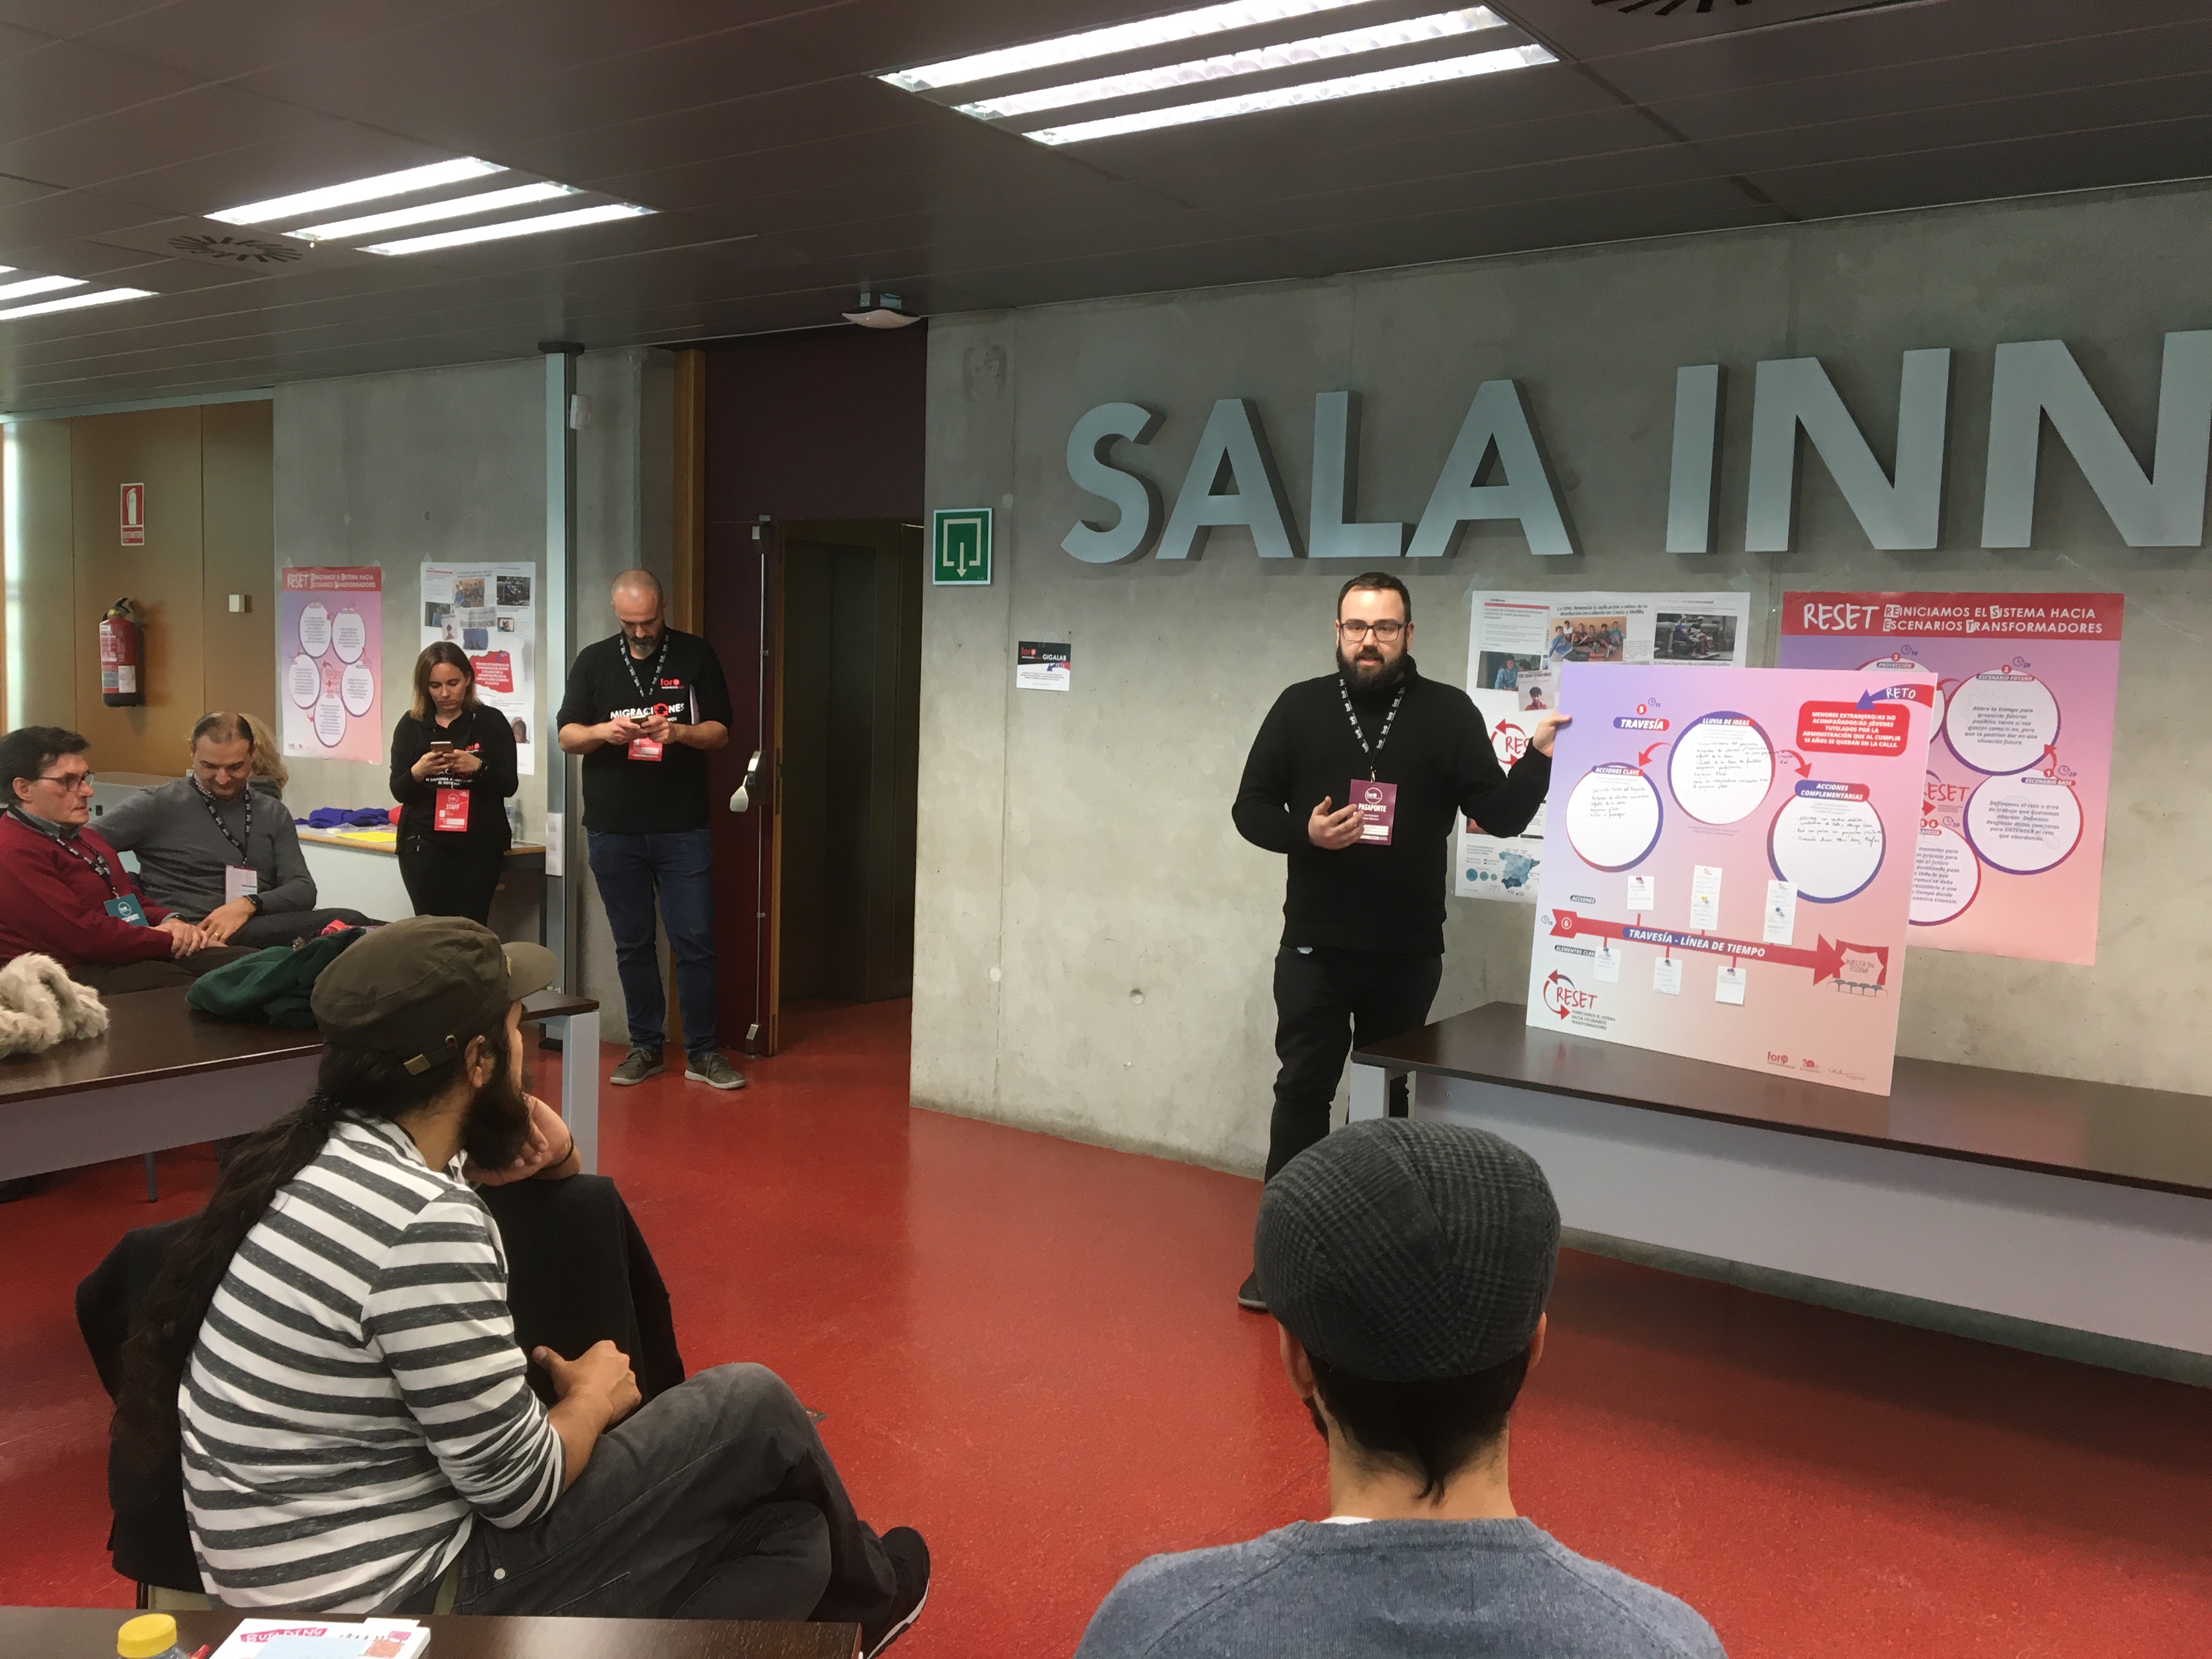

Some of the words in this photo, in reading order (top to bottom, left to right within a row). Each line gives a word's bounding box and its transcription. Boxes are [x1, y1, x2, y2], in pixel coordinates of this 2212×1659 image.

[1060, 379, 1575, 564] SALA
[1666, 329, 2212, 553] INN
[287, 573, 309, 588] RESET
[1804, 603, 1880, 630] RESET
[1884, 604, 1970, 618] REINICIAMOS
[1975, 607, 1987, 617] EL
[1990, 605, 2045, 619] SISTEMA
[2051, 608, 2095, 618] HACIA
[1883, 618, 1962, 631] ESCENARIOS
[1966, 619, 2102, 633] TRANSFORMADORES
[1886, 687, 1916, 699] RETO
[1621, 718, 1663, 730] TRAVESÍA
[1813, 718, 1867, 726] ACOMPAÑADOS/AS:
[1803, 731, 1852, 739] ADMINISTRACIÓN
[1801, 790, 1864, 800] COMPLEMENTARIAS
[1924, 782, 1971, 802] ESET
[1358, 803, 1386, 812] PASAPORTE
[1629, 929, 1672, 944] TRAVESÍA
[1680, 935, 1708, 949] LÍNEA
[1711, 941, 1724, 951] DE
[1727, 943, 1765, 957] TIEMPO
[1556, 946, 1582, 955] ELEMENTOS
[1847, 958, 1866, 968] PUESTA
[1850, 965, 1869, 974] ESCENA
[1556, 986, 1598, 1009] RESET
[1571, 1020, 1607, 1030] TRANSFORMADORES
